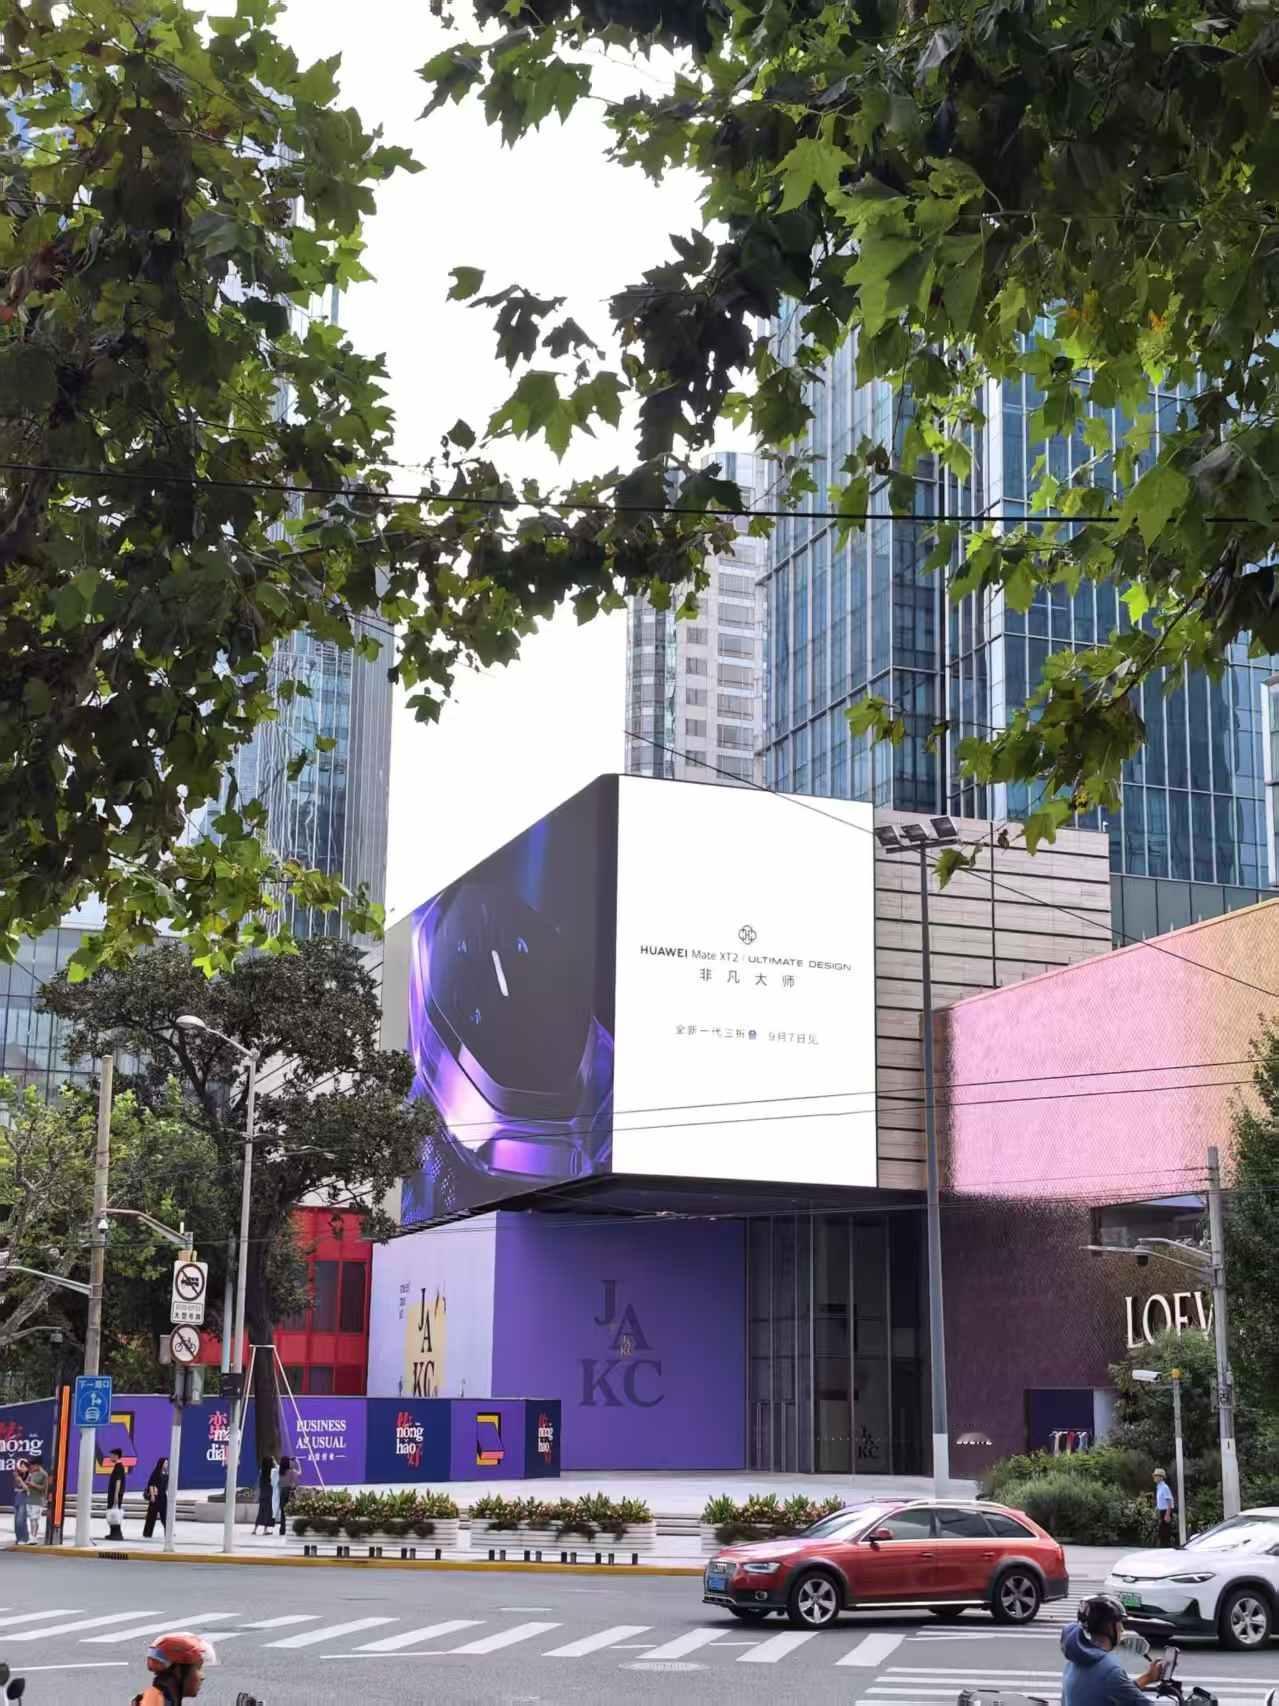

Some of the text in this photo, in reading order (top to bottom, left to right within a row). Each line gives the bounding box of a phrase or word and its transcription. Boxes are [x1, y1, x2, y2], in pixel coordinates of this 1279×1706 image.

[640, 945, 852, 971] HUAWEI Mate XT2 ULTIMATE DESIGN
[700, 967, 795, 988] 非凡大师
[296, 1419, 346, 1432] BUSINESS
[312, 1436, 346, 1449] USUAL
